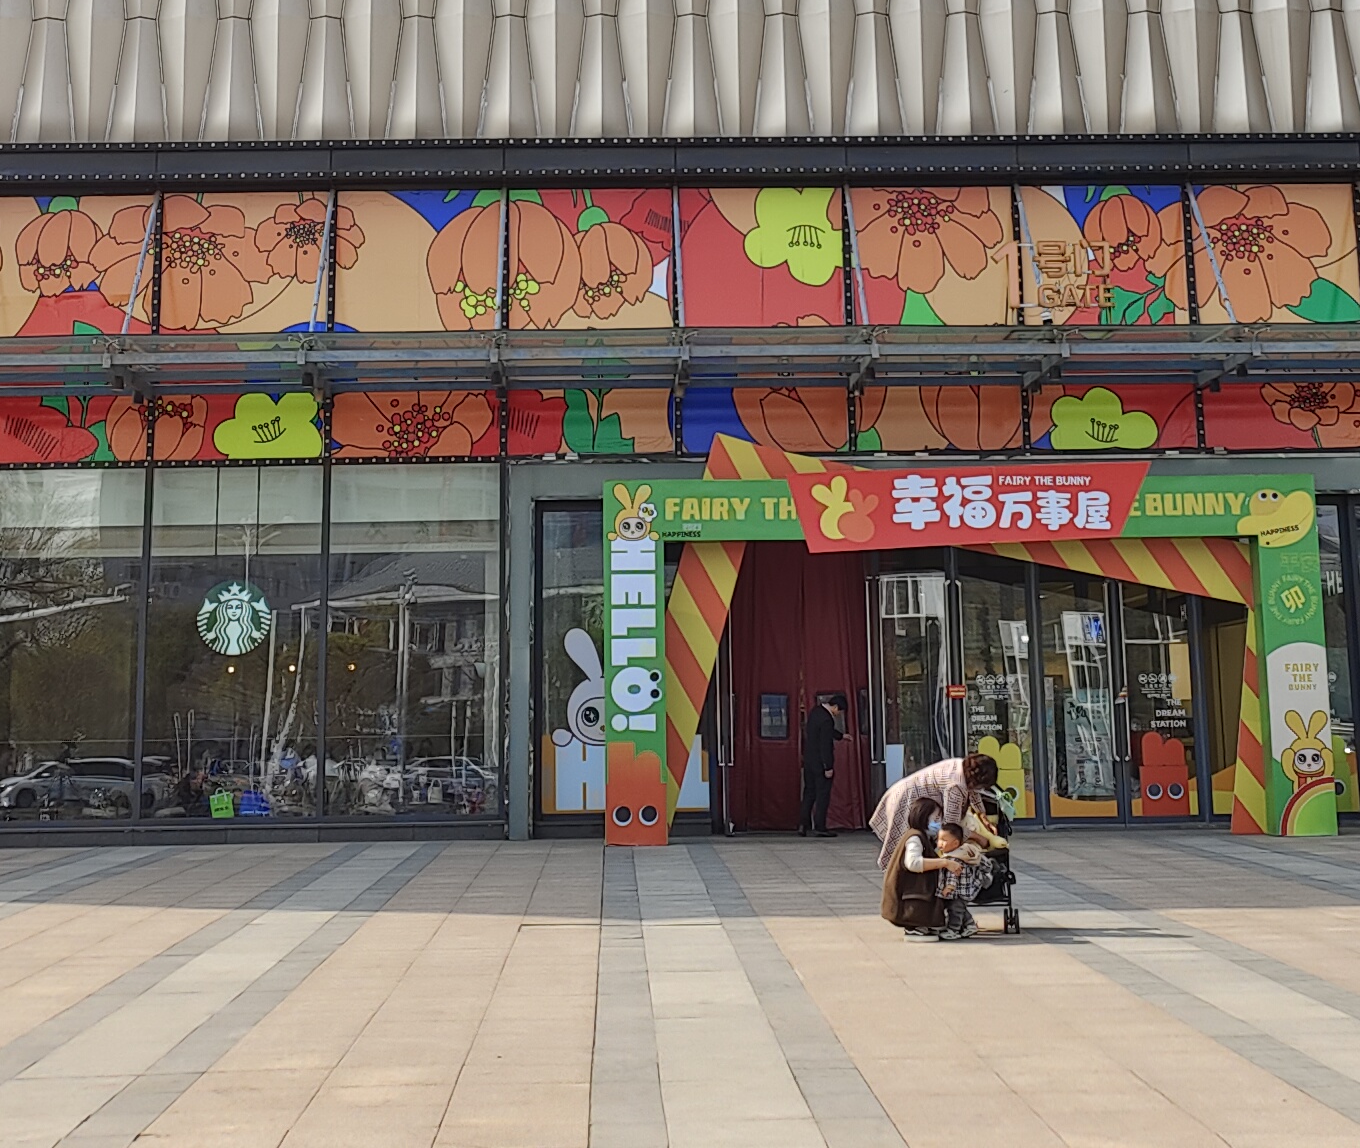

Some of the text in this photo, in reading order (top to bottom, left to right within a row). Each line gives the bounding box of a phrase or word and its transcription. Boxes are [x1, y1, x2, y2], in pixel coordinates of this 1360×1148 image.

[1037, 283, 1116, 308] GATE
[998, 475, 1091, 486] FAIRY THE BUNNY
[891, 474, 1112, 531] 幸福万事屋
[1146, 493, 1245, 516] BUNNY
[665, 498, 797, 521] FAIRY TH
[1260, 524, 1300, 536] HAPPINESS
[611, 539, 664, 732] HELLO!
[1284, 663, 1320, 673] FAIRY
[1292, 673, 1313, 683] THE
[1288, 683, 1317, 691] BUNNY
[1155, 709, 1186, 717] DREAM
[1150, 720, 1187, 728] STATION
